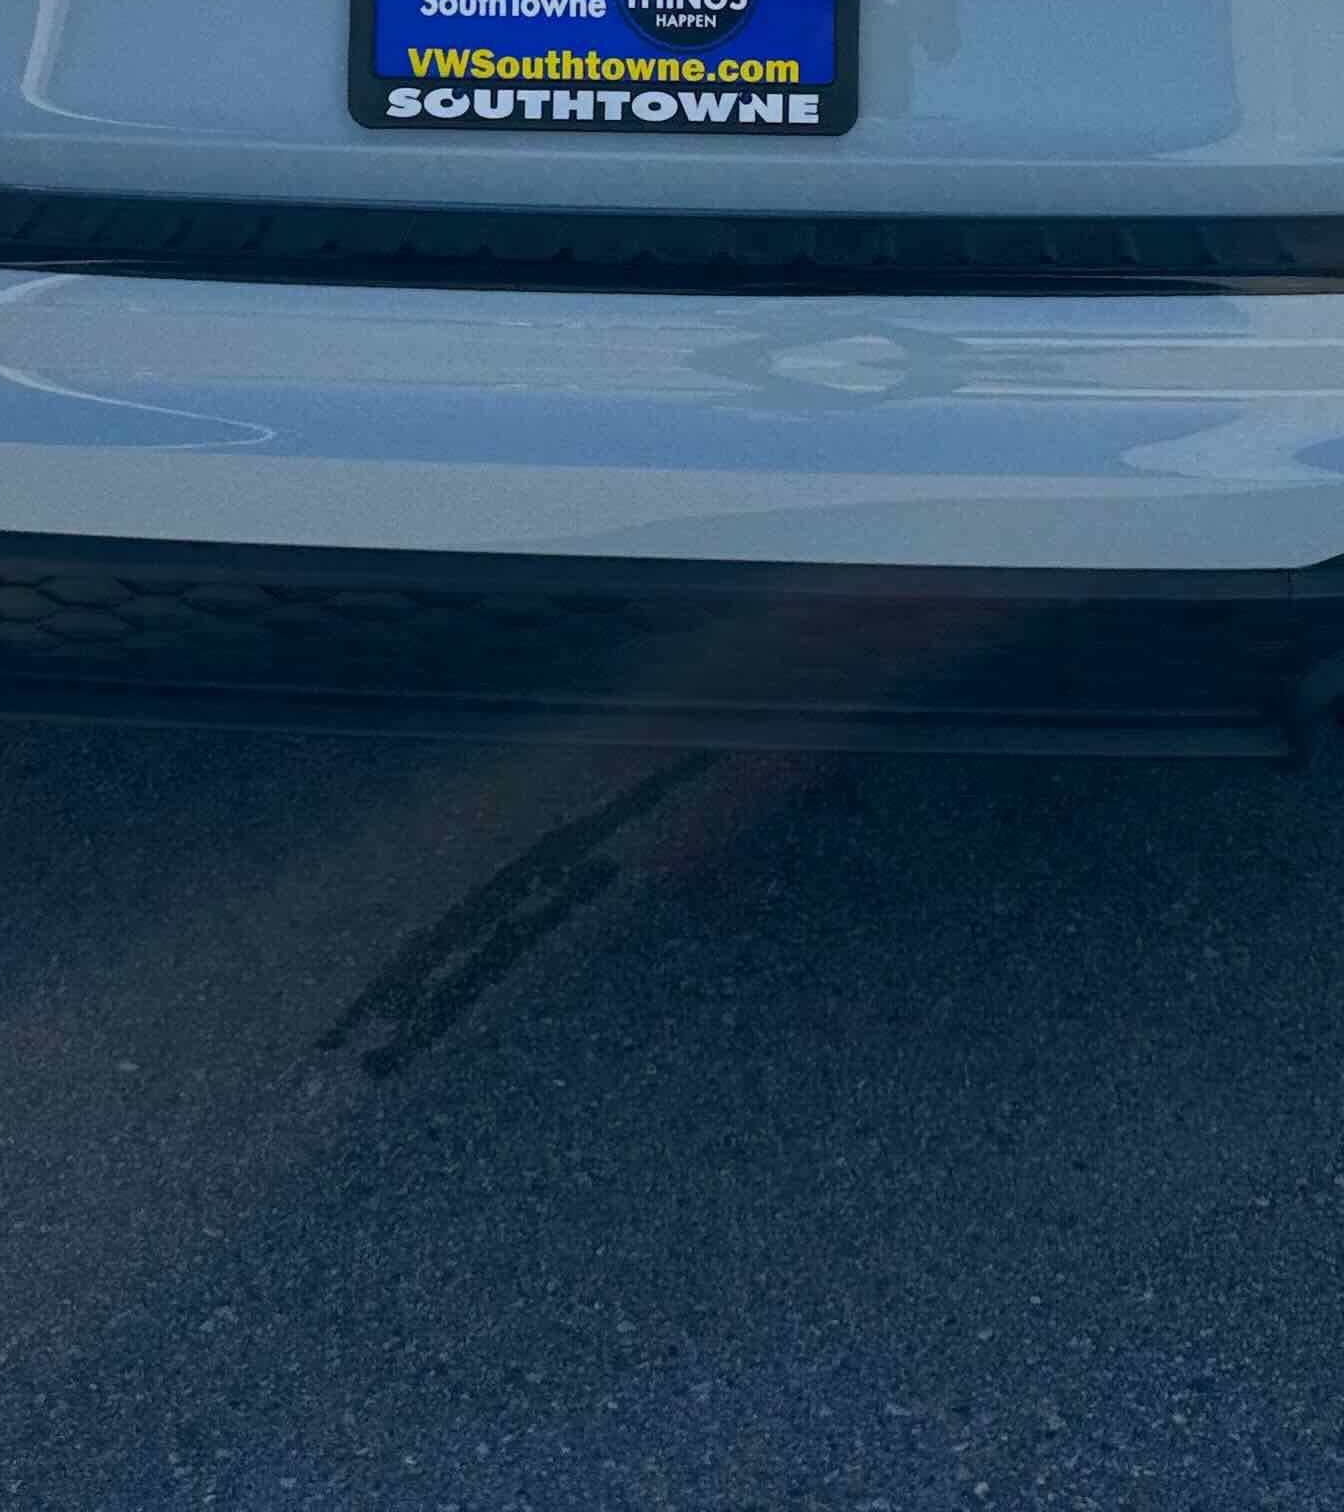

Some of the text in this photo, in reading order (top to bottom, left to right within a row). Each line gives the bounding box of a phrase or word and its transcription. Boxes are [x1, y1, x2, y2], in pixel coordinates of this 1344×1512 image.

[655, 13, 717, 29] HAPPEN
[407, 48, 800, 84] VWSouthtowne.com
[386, 87, 820, 125] SOUTHTOWNE
